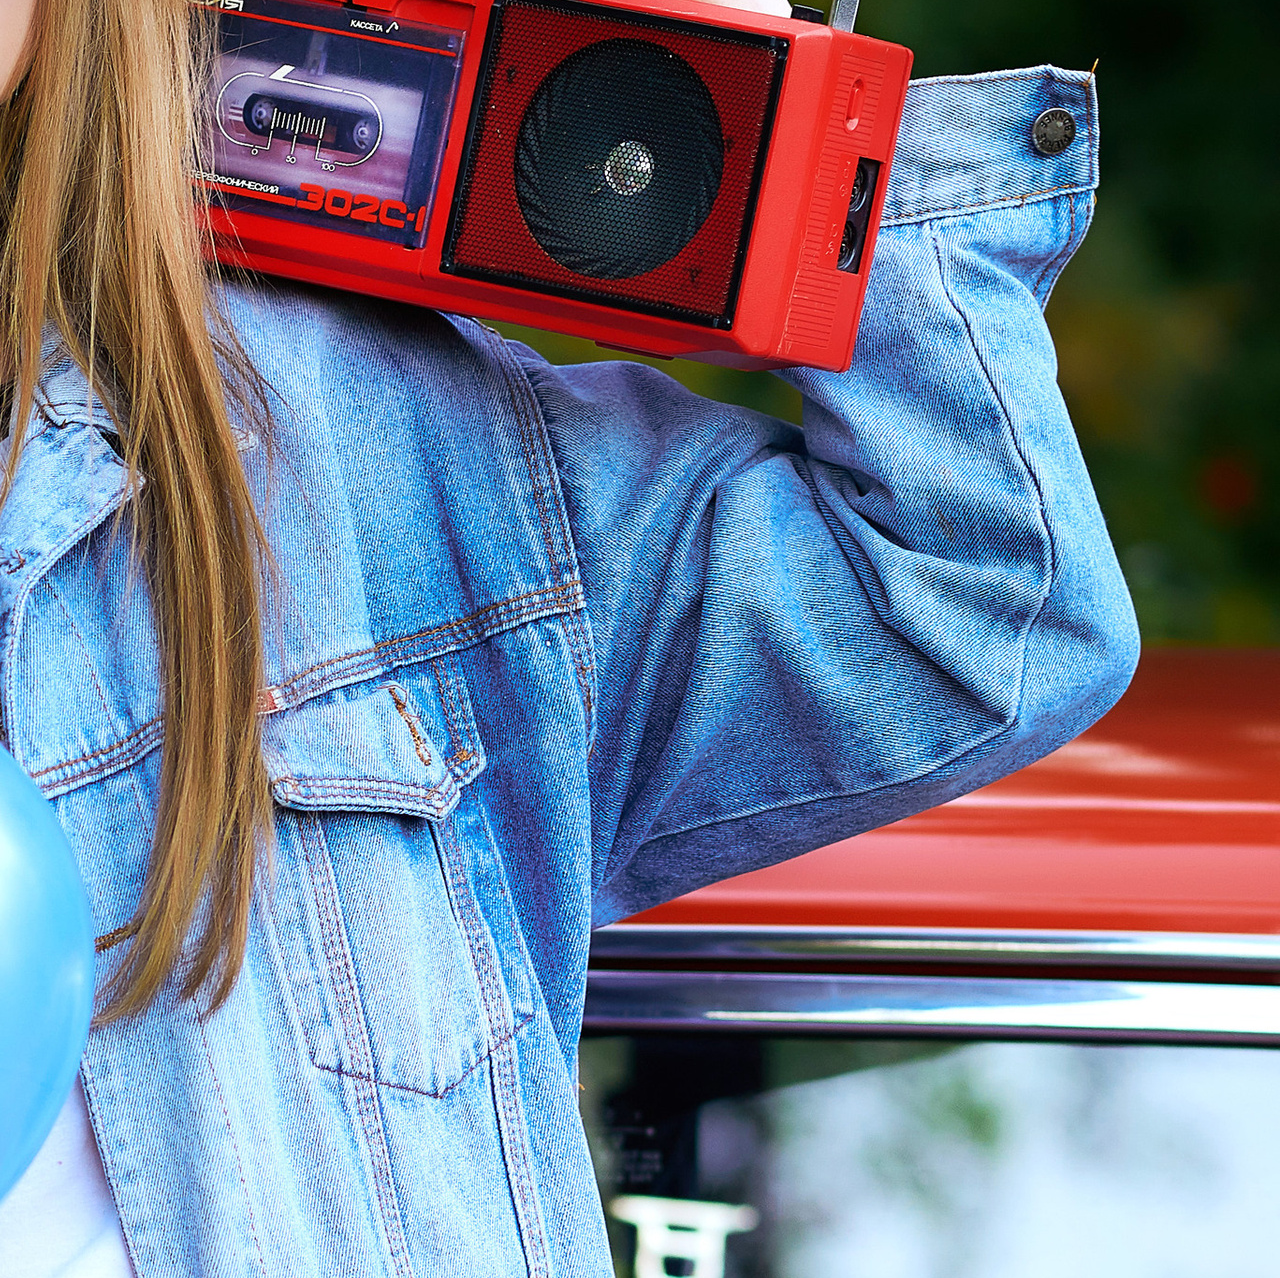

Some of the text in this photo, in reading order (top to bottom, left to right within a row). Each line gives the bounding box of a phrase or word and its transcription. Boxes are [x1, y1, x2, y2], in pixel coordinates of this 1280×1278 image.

[350, 19, 384, 32] КАССЕТА
[251, 148, 259, 156] 0
[285, 155, 297, 164] 50
[321, 163, 336, 172] 100
[190, 169, 280, 195] ТЕРЕОФОНИЧЕСКИЙ
